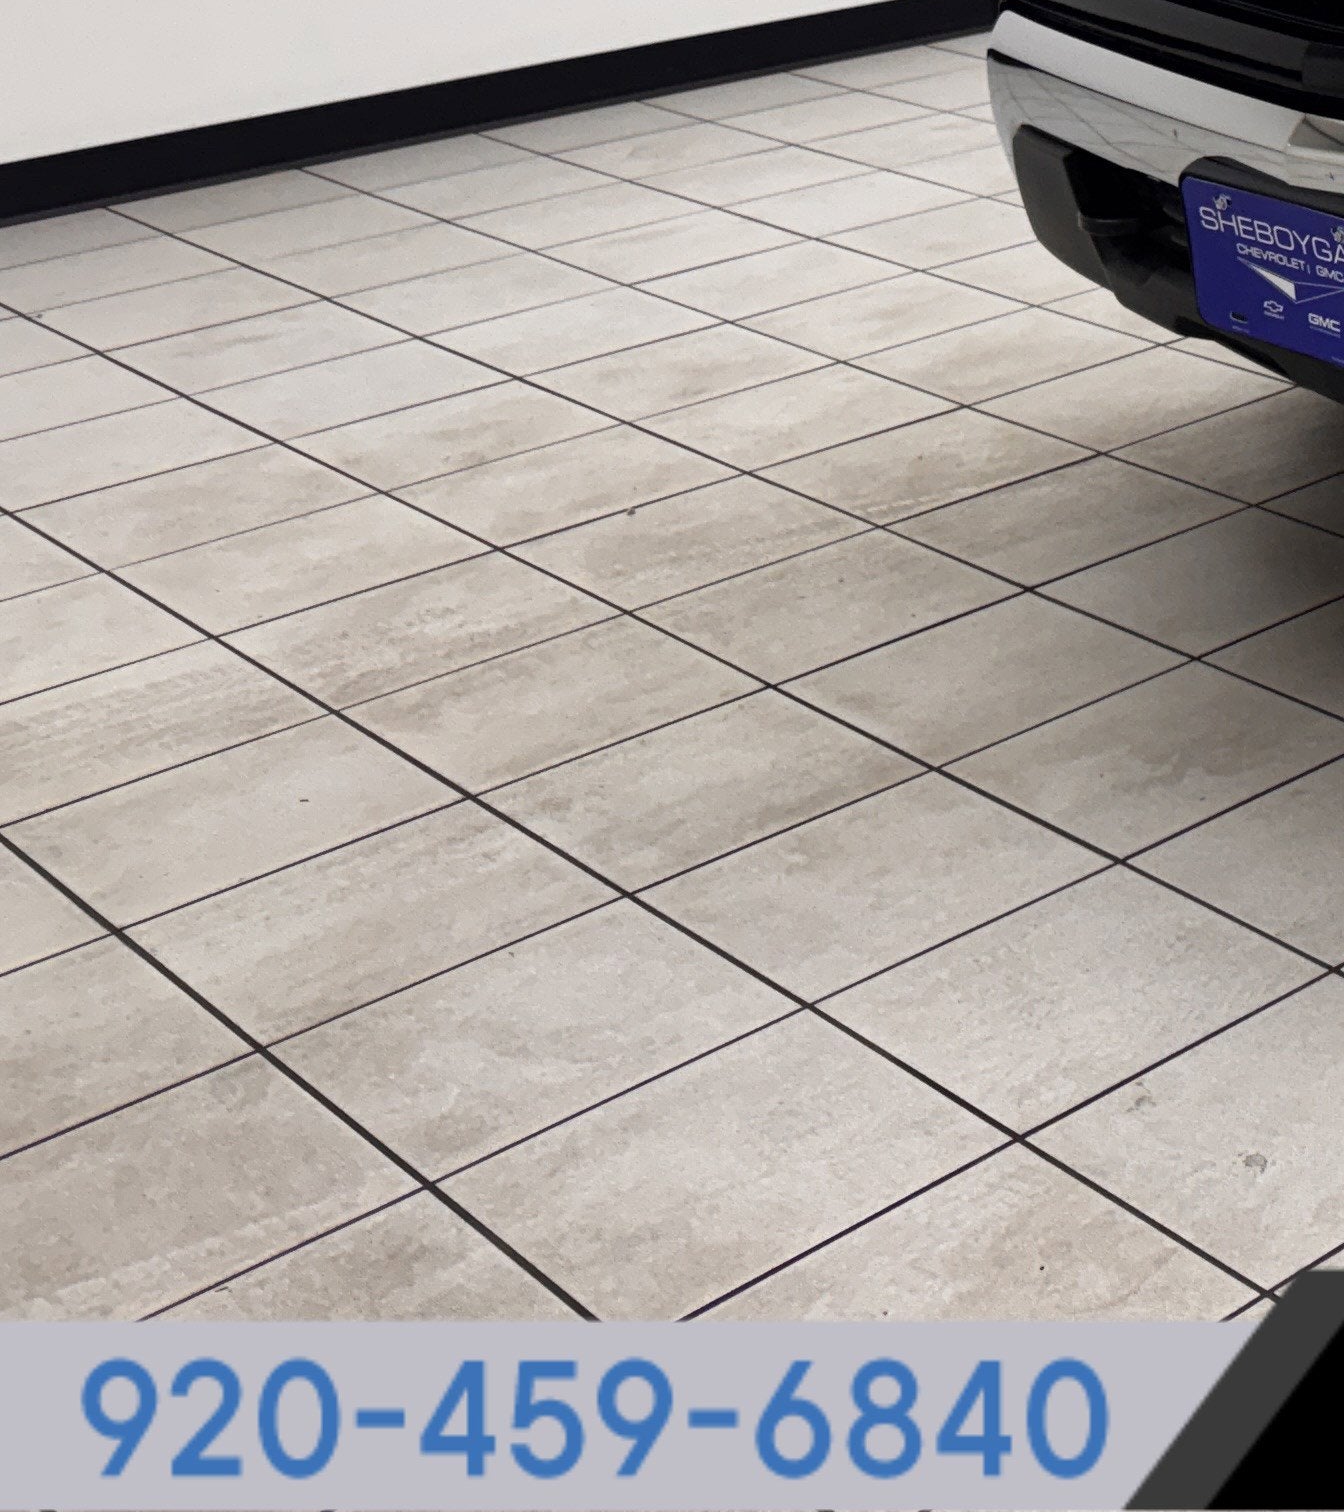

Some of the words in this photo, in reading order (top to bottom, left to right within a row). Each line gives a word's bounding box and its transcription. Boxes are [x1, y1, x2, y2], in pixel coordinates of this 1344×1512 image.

[1236, 242, 1305, 271] CHEVROLET
[1316, 265, 1344, 283] GMC
[1308, 312, 1341, 333] GMC
